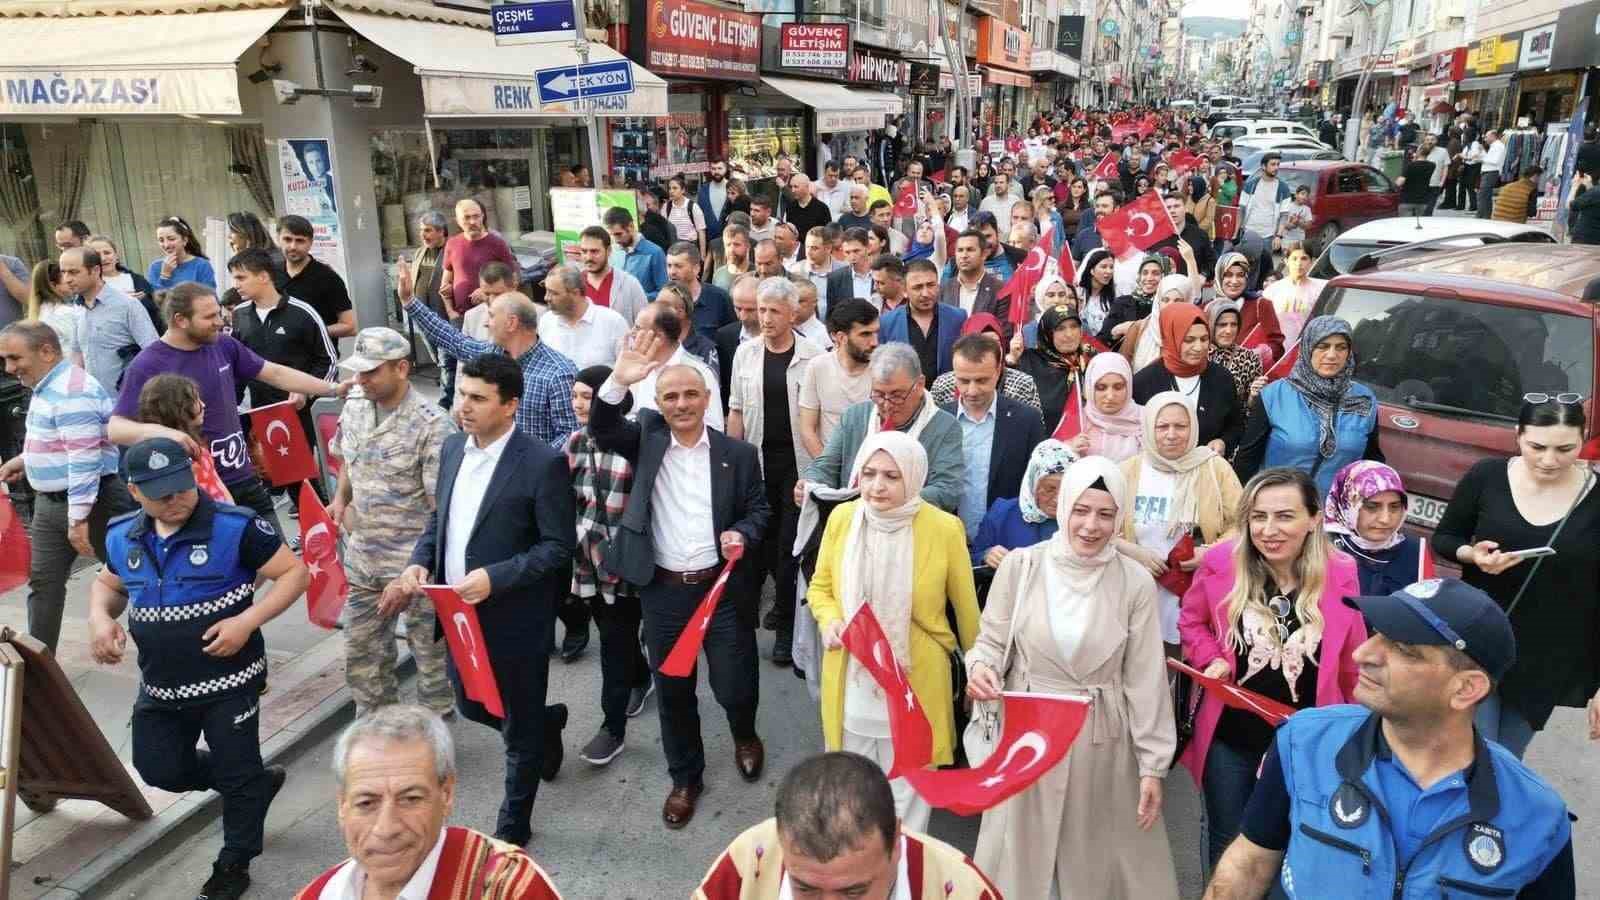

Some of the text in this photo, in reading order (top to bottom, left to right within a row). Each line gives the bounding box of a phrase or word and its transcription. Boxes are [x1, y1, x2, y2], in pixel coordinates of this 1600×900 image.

[496, 9, 535, 26] ÇEŞME
[670, 5, 759, 51] GÜVENÇ İLETİŞİM
[788, 25, 843, 38] GÜVENÇ
[789, 36, 841, 50] İLETİŞİM
[6, 72, 160, 104] MAĞAZASI
[570, 70, 625, 88] TEK YÖN
[494, 85, 533, 109] RENK
